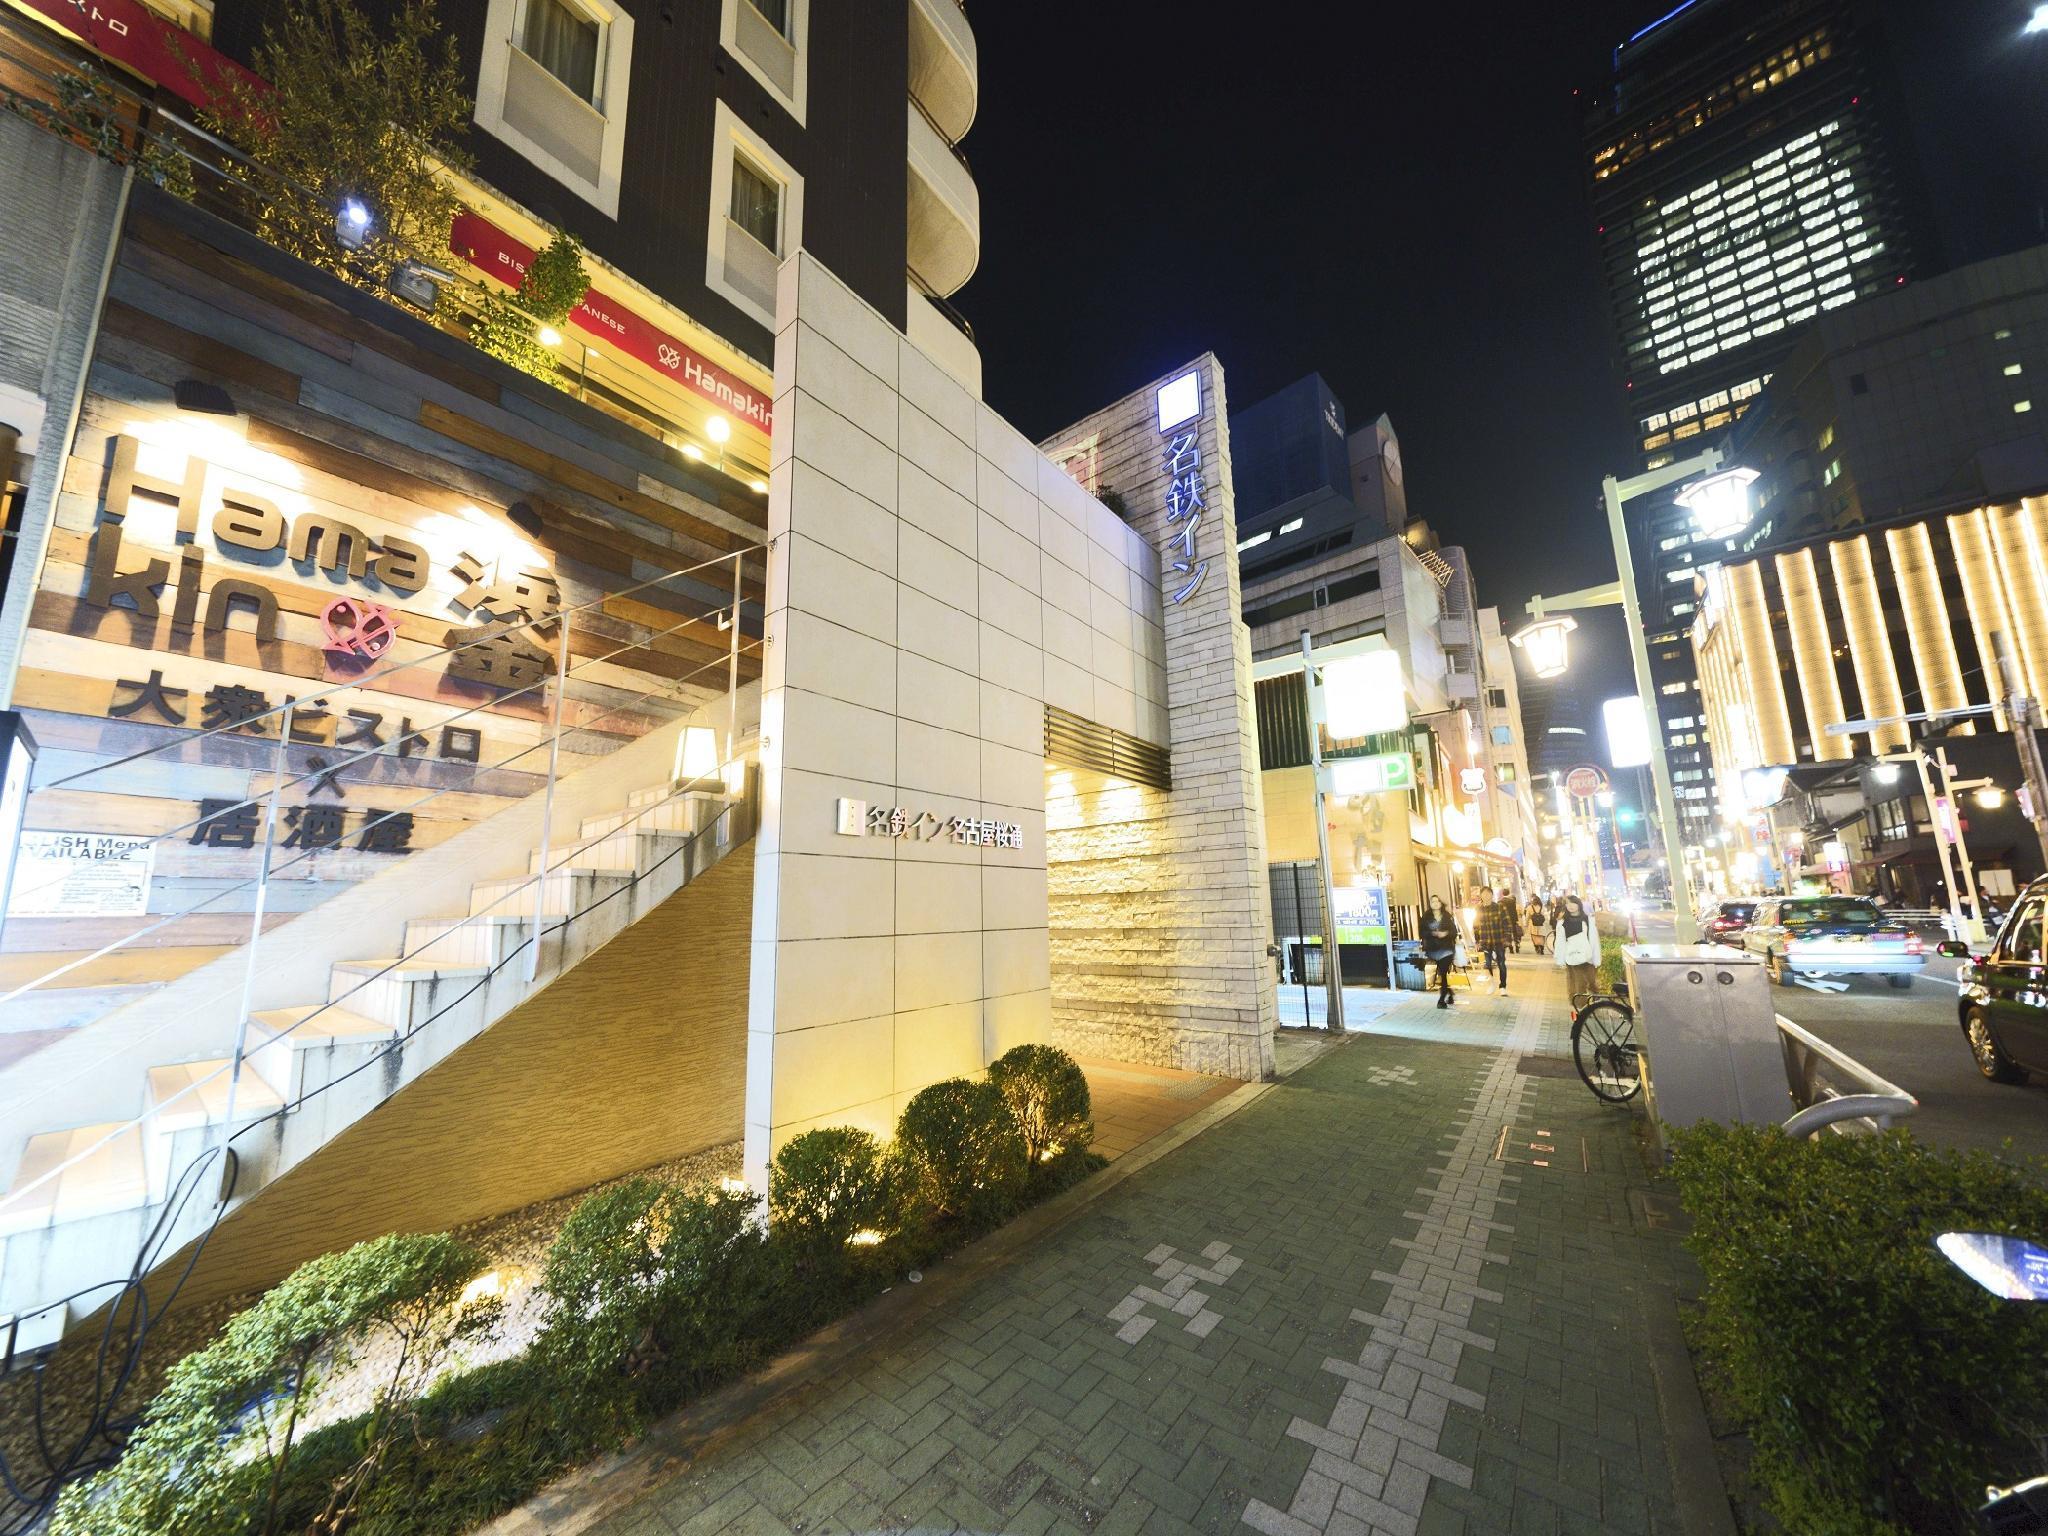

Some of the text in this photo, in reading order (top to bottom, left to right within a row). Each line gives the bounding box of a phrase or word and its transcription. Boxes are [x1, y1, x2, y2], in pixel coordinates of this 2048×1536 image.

[102, 433, 431, 592] Hama
[1162, 430, 1210, 605] 名鉄イン
[89, 524, 280, 642] kin
[107, 669, 482, 763] 大衆ビストロ
[1382, 758, 1407, 788] P
[188, 798, 420, 855] 居酒屋
[868, 805, 1024, 849] 名鉄イン 名古屋桜通
